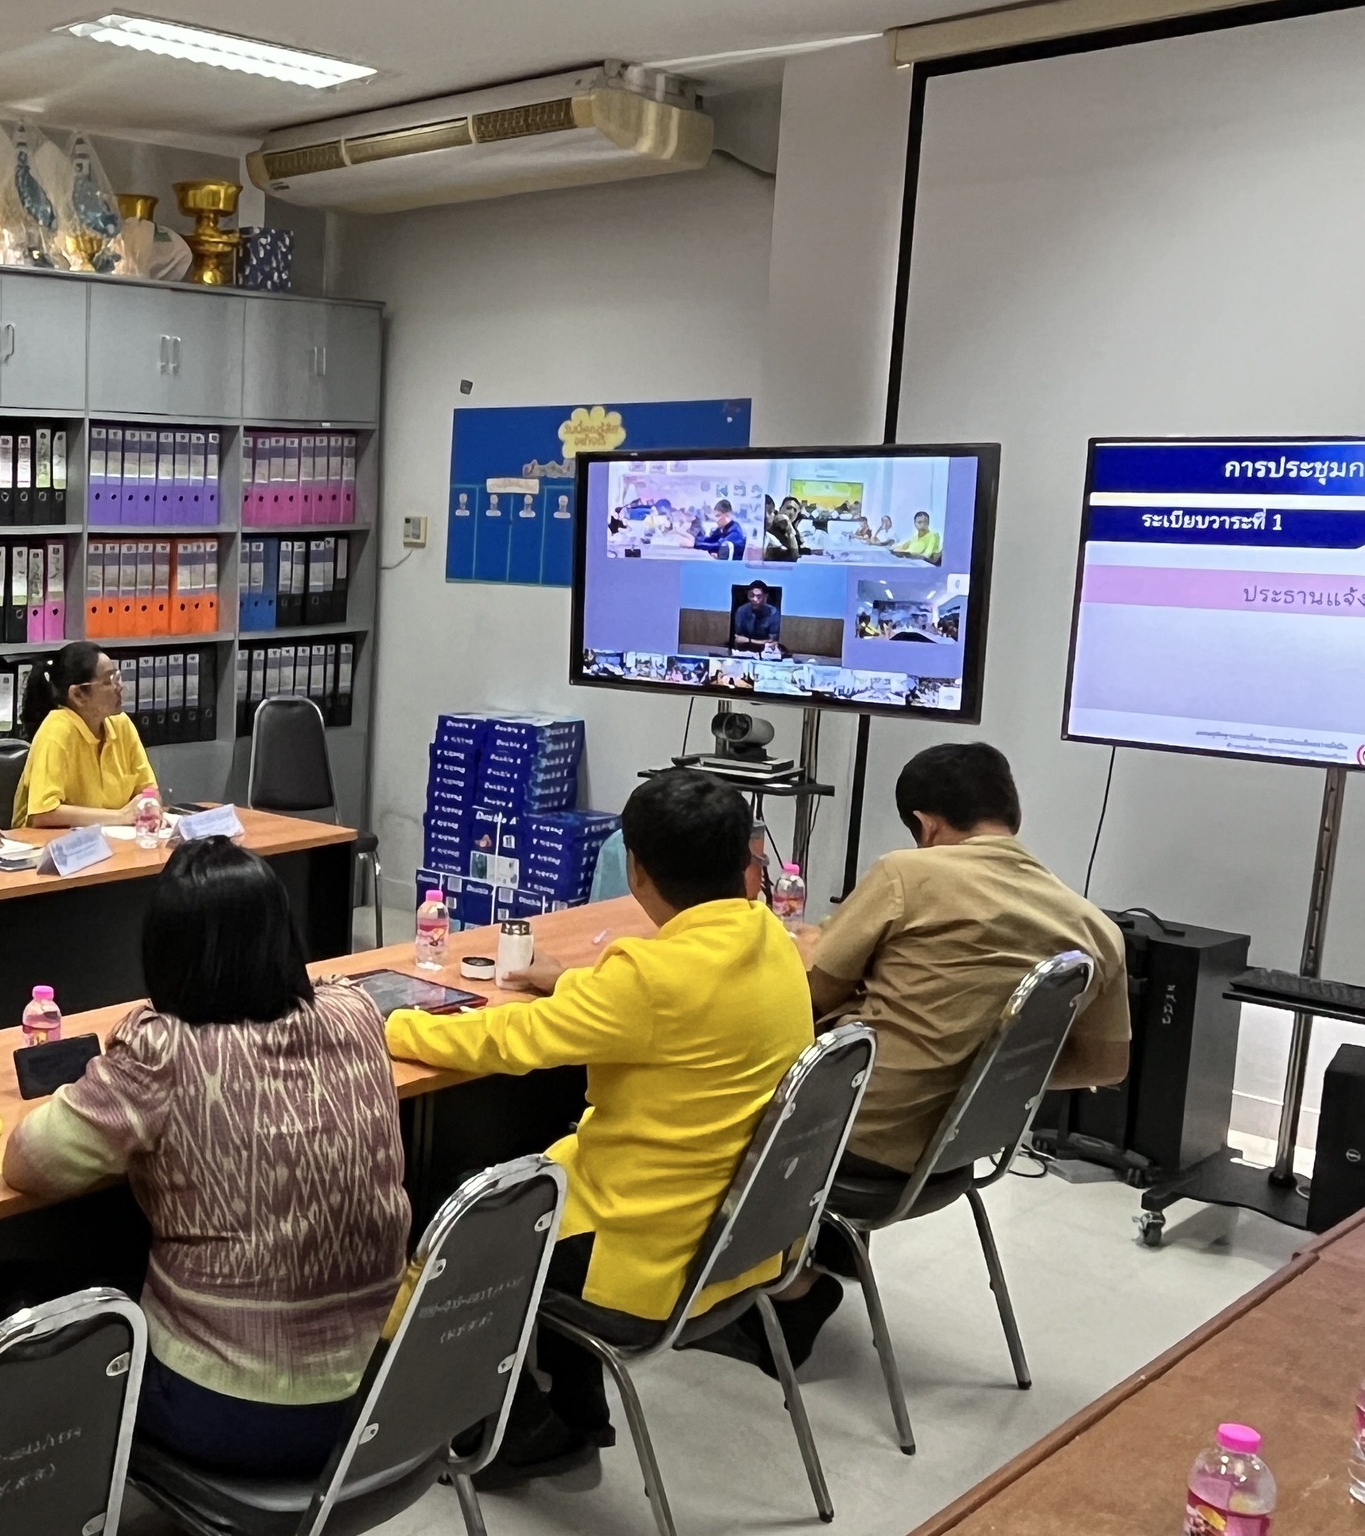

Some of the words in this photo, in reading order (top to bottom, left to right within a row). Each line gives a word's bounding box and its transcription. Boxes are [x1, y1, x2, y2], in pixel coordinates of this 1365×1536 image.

[1224, 455, 1365, 486] การประชุมก
[1141, 507, 1267, 531] ระเบียบวาระที่
[1272, 514, 1283, 531] 1
